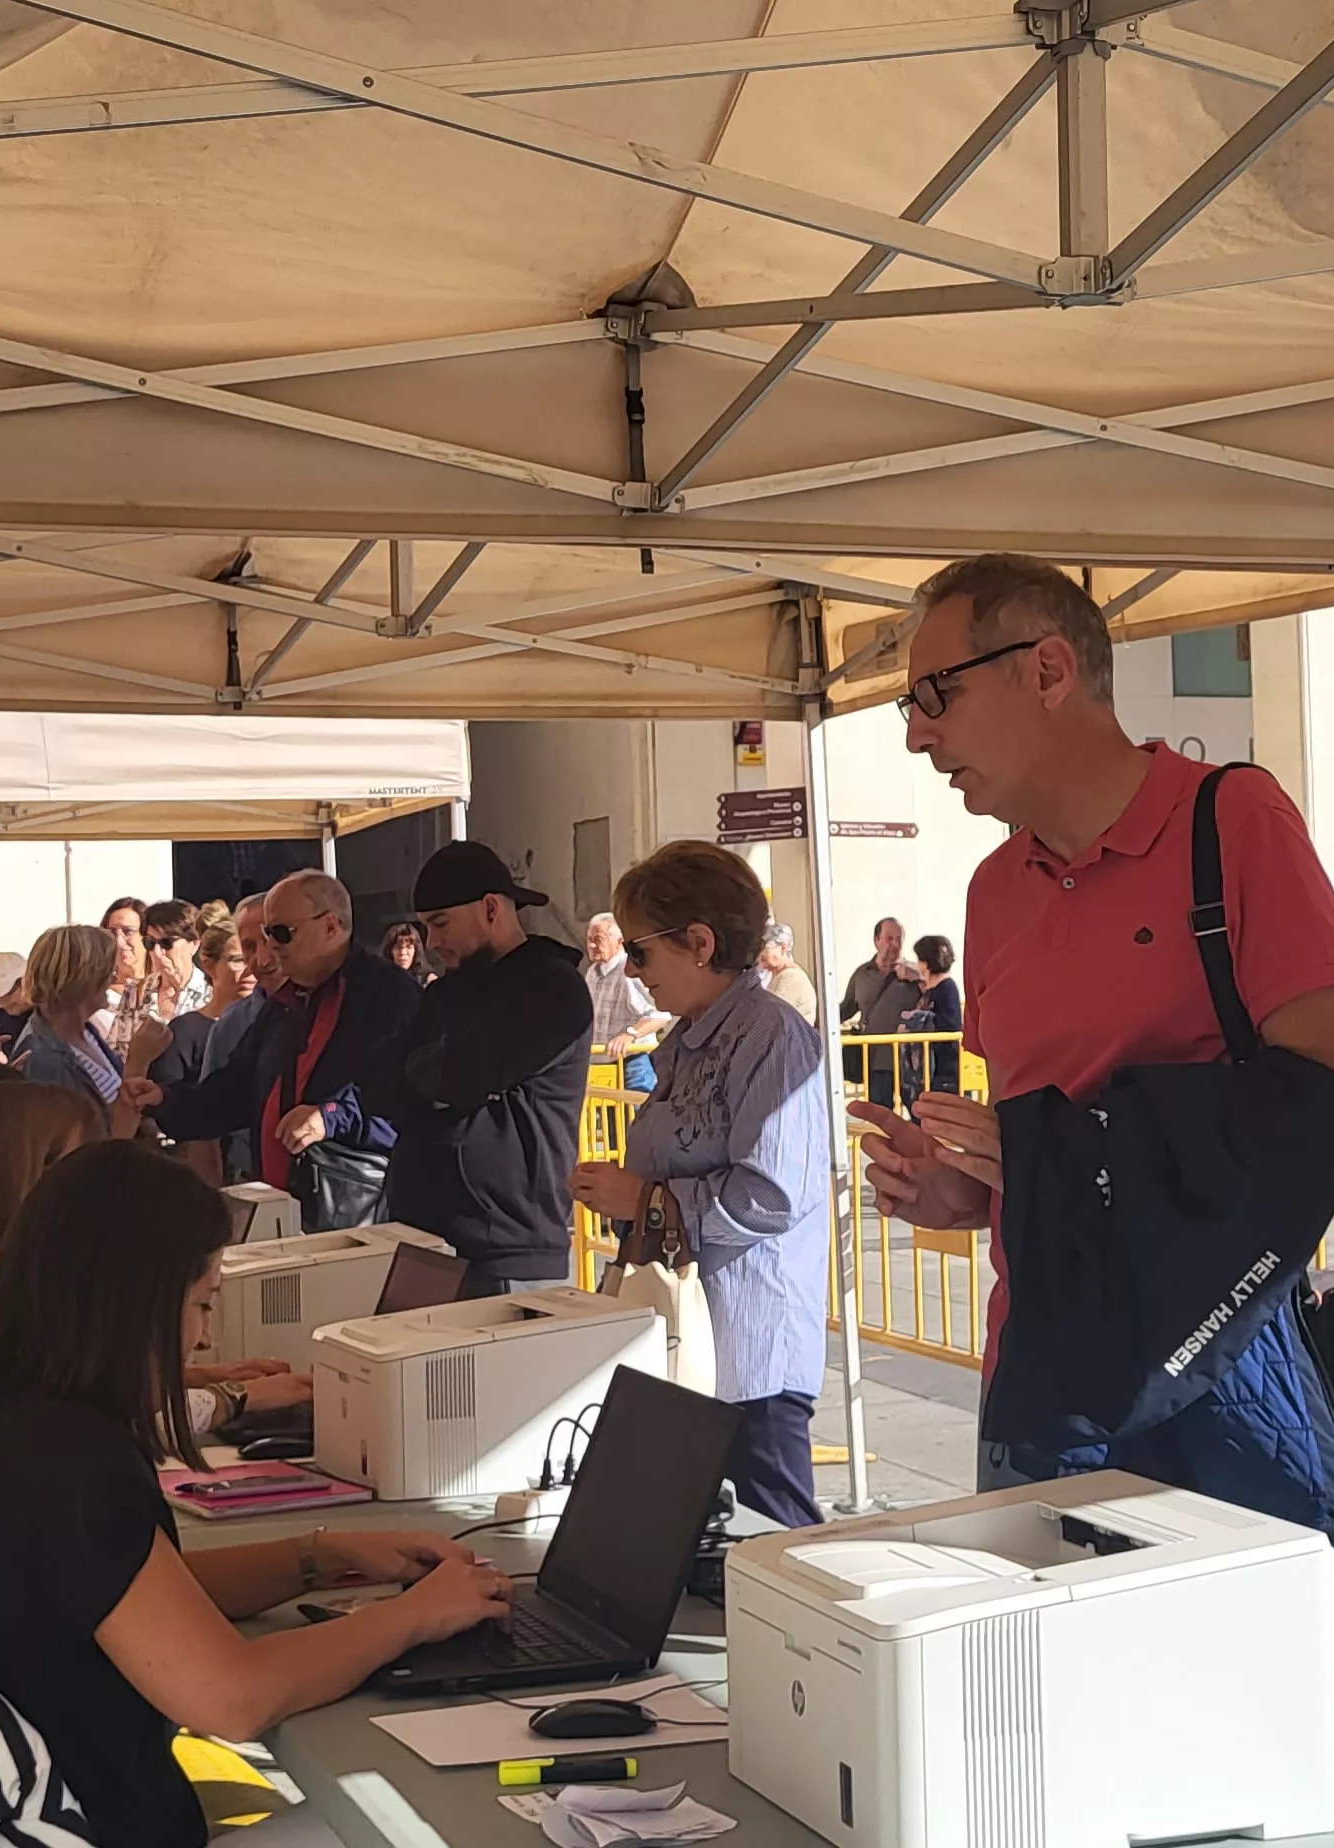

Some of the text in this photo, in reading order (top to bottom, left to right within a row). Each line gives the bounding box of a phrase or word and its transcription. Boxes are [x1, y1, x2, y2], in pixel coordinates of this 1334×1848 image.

[369, 786, 427, 796] MASTERTENT
[1163, 1250, 1282, 1378] HELLY HANSEN
